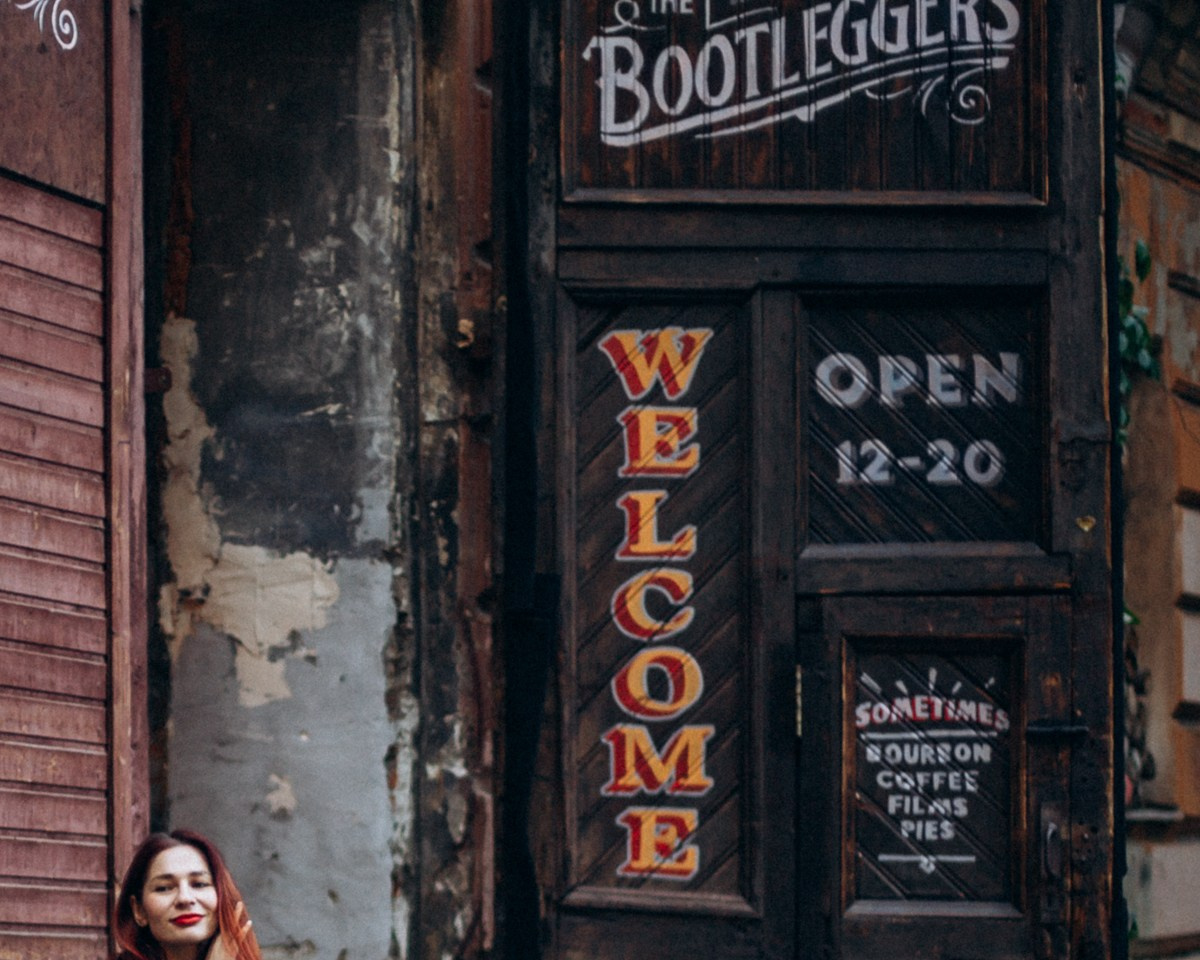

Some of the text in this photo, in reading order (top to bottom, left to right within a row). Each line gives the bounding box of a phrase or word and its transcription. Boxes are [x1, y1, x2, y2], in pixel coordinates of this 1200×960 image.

[815, 352, 1022, 408] OPEN
[836, 438, 1004, 485] 12-20
[598, 326, 714, 880] WELCOME
[855, 695, 1010, 731] SOMETIMES
[876, 770, 979, 793] COFFEE
[887, 795, 968, 817] FILMS
[901, 820, 955, 840] PIES
